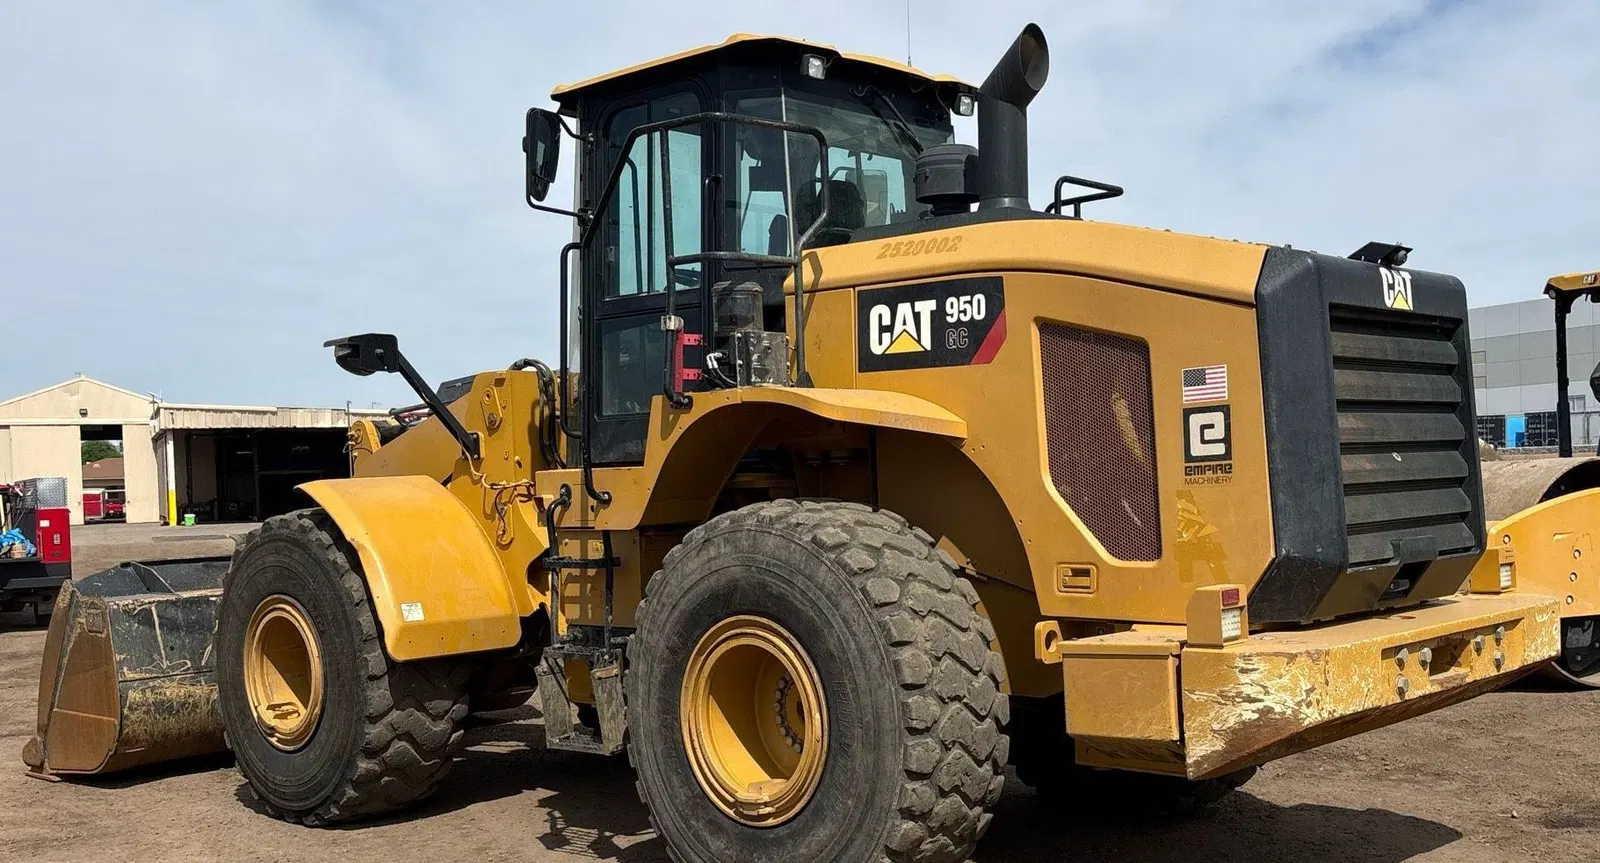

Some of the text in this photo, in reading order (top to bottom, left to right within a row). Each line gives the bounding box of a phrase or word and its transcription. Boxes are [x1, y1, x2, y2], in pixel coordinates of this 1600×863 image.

[1379, 266, 1414, 311] CAT
[1583, 274, 1596, 285] CAT
[869, 293, 986, 355] CAT 950
[945, 327, 969, 349] GC
[1184, 476, 1233, 486] MACHINERY
